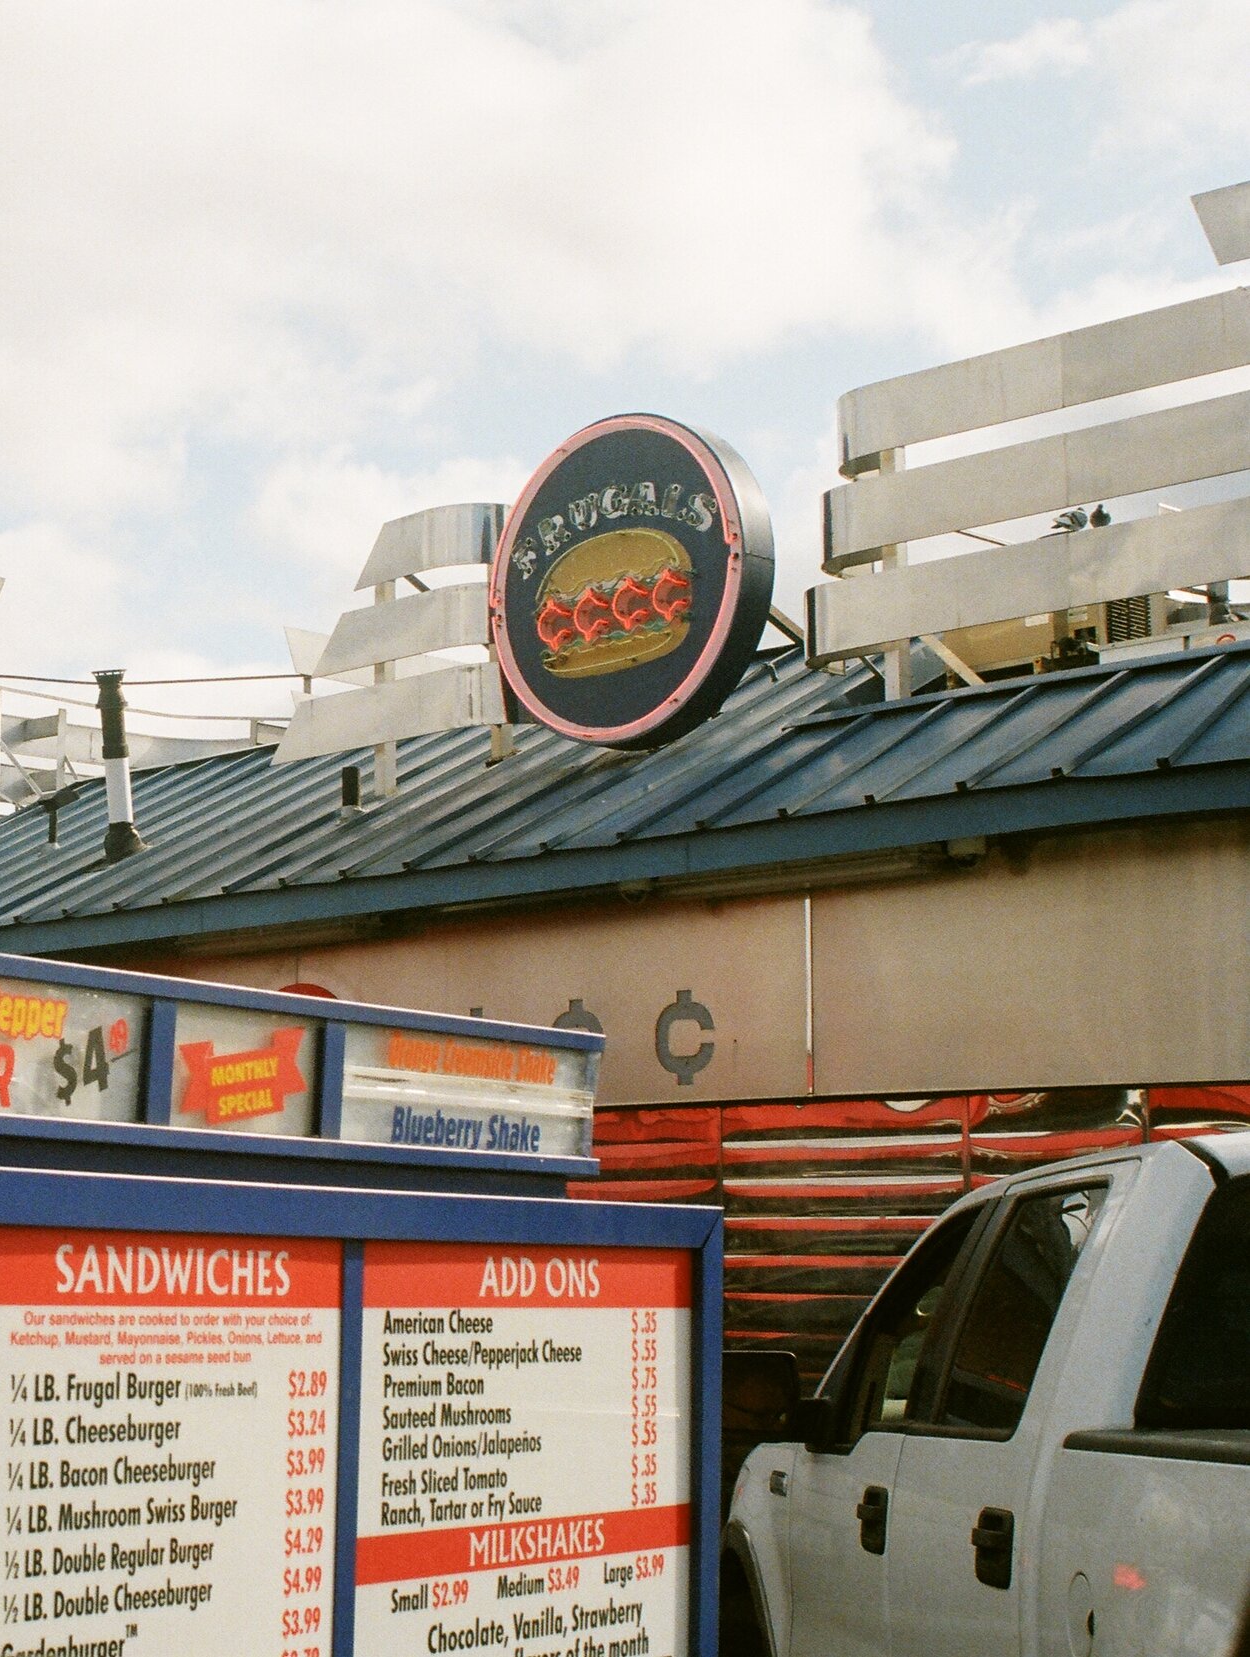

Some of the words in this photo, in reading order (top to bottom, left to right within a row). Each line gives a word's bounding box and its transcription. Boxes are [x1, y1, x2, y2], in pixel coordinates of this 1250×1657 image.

[210, 1056, 279, 1087] MONTHLY
[219, 1089, 274, 1117] SPECIAL
[391, 1106, 483, 1149] Blueberry
[486, 1113, 541, 1153] Shake
[56, 1244, 291, 1296] SANDWICHES
[479, 1256, 536, 1297] ADD
[546, 1258, 600, 1297] ONS
[24, 1311, 45, 1326] Our
[49, 1311, 115, 1326] sandwiches
[119, 1315, 135, 1326] are
[139, 1313, 177, 1326] cooked
[180, 1314, 189, 1326] to
[193, 1312, 219, 1326] order
[223, 1313, 243, 1326] with
[244, 1315, 265, 1329] your
[268, 1313, 298, 1326] choice
[384, 1310, 444, 1334] American
[449, 1310, 493, 1334] Cheese
[306, 1332, 322, 1345] and
[383, 1344, 418, 1366] Swiss
[423, 1339, 538, 1370] Cheese/Pepperjack
[542, 1339, 582, 1363] Cheese
[99, 1351, 137, 1365] served
[140, 1354, 152, 1365] on
[156, 1354, 162, 1364] a
[165, 1354, 204, 1365] sesame
[207, 1352, 230, 1365] seed
[233, 1352, 251, 1364] bun
[34, 1374, 59, 1401] LB.
[67, 1371, 119, 1407] Frugal
[127, 1374, 181, 1405] Burger
[215, 1383, 236, 1399] Fresh
[288, 1371, 326, 1399] $2.89
[384, 1372, 442, 1398] Premium
[447, 1374, 484, 1395] Bacon
[33, 1418, 58, 1445] LB.
[66, 1415, 181, 1447] Cheeseburger
[287, 1410, 326, 1438] $3.24
[383, 1403, 436, 1429] Sauteed
[441, 1405, 511, 1427] Mushrooms
[382, 1435, 428, 1461] Grilled
[29, 1462, 54, 1489] LB.
[60, 1461, 108, 1487] Bacon
[114, 1455, 216, 1487] Cheeseburger
[286, 1448, 325, 1478] $3.99
[382, 1471, 416, 1497] Fresh
[421, 1468, 459, 1493] Sliced
[463, 1468, 507, 1491] Tomato
[28, 1506, 52, 1533] LB.
[58, 1502, 141, 1532] Mushroom
[146, 1497, 185, 1524] Swiss
[190, 1495, 237, 1528] Burger
[286, 1488, 323, 1518] $3.99
[381, 1501, 426, 1527] Ranch,
[430, 1498, 467, 1522] Tartar
[471, 1503, 482, 1518] or
[487, 1496, 505, 1522] Fry
[509, 1493, 542, 1515] Sauce
[25, 1550, 47, 1578] LB.
[53, 1546, 106, 1575] Double
[111, 1539, 165, 1574] Regular
[169, 1538, 213, 1573] Burger
[284, 1528, 323, 1557] $4.29
[469, 1518, 605, 1567] MILKSHAKES
[24, 1593, 47, 1621] LB.
[53, 1586, 108, 1618] Double
[114, 1581, 213, 1614] Cheeseburger
[283, 1568, 321, 1597] $4.99
[391, 1587, 428, 1614] Small
[432, 1580, 469, 1610] $2.99
[497, 1573, 545, 1601] Medium
[548, 1566, 579, 1595] $3.49
[603, 1562, 633, 1588] Large
[636, 1553, 664, 1581] $3.99
[282, 1607, 320, 1638] $3.99
[428, 1619, 509, 1655] Chocolate,
[513, 1607, 567, 1643] Vanilla,
[572, 1600, 643, 1633] Strawberry
[582, 1634, 605, 1657] the
[608, 1628, 648, 1657] month
